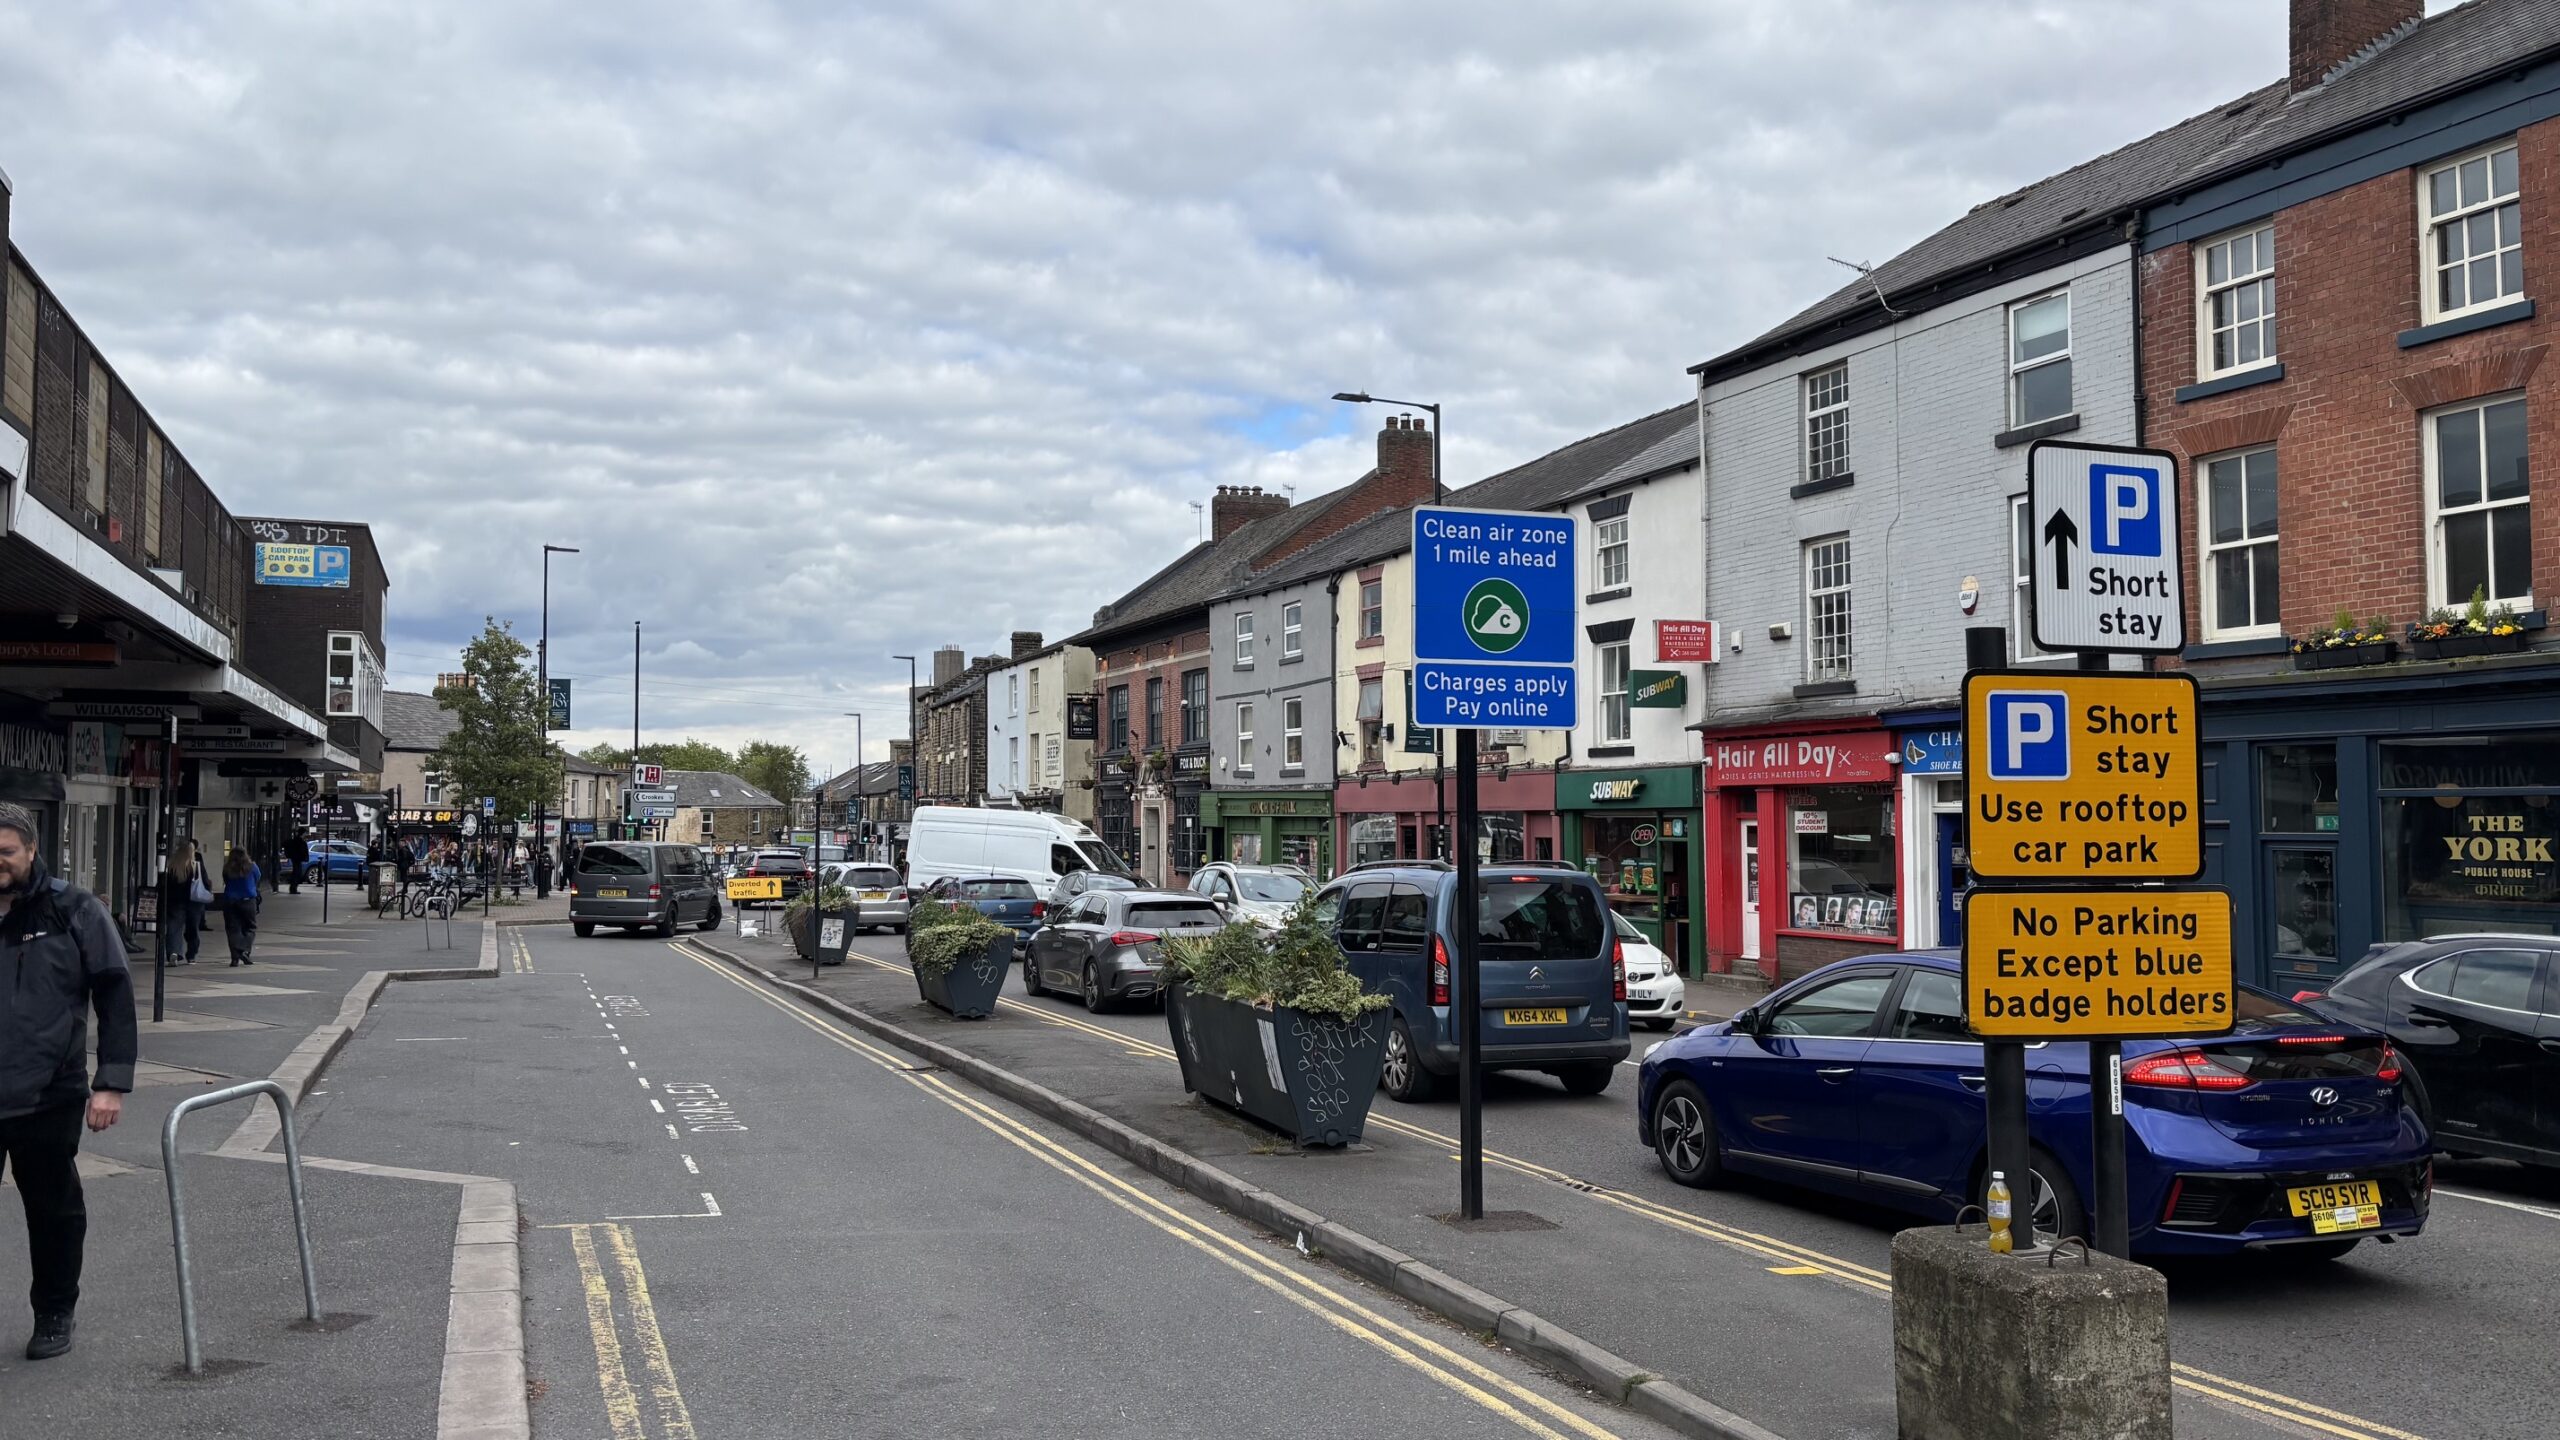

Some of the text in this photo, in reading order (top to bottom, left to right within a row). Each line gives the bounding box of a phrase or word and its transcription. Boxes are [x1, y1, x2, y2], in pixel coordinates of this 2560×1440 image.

[2105, 473, 2149, 547] P
[1423, 518, 1567, 545] Clean air zone
[268, 554, 310, 563] CAR PARK
[319, 551, 344, 573] P
[1433, 544, 1557, 568] 1 mile ahead
[2089, 567, 2169, 598] Short
[1500, 614, 1511, 628] C
[1663, 625, 1706, 635] Hair All Day
[2099, 607, 2163, 641] stay
[1424, 671, 1568, 697] Charges apply
[1636, 675, 1679, 701] SUBWAY
[75, 703, 173, 717] WILLIAMSONS
[1445, 696, 1548, 719] Pay online
[2086, 704, 2178, 735] Short
[215, 740, 276, 749] RESTAURANT
[2007, 701, 2054, 769] P
[0, 722, 65, 773] WILLIAMSONS
[1106, 764, 1115, 774] FOX
[1180, 758, 1189, 769] FOX
[1194, 756, 1206, 768] DUCK
[1718, 745, 1756, 770] Hair
[1764, 742, 1789, 768] All
[1798, 741, 1836, 777] Day
[1930, 761, 1951, 770] SHOE
[2097, 745, 2170, 779] stay
[291, 776, 312, 785] COSTA
[648, 767, 657, 778] H
[1718, 772, 1740, 780] LADIES
[1749, 771, 1769, 779] GENTS
[1771, 770, 1821, 778] HAIRDRESSING
[289, 789, 314, 799] COFFEE
[1590, 778, 1640, 800] SUBWAY
[486, 798, 492, 807] P
[1980, 793, 2188, 827] Use rooftop
[388, 810, 452, 821] GRAB & GO
[2468, 815, 2524, 832] THE
[1634, 829, 1654, 841] OPEN
[2013, 835, 2159, 869] car park
[2442, 836, 2556, 863] YORK
[2464, 866, 2533, 878] PUBLIC HOUSE
[2012, 906, 2198, 940] No Parking
[1997, 947, 2203, 982] Except blue
[1638, 989, 1652, 998] ULY
[1983, 986, 2226, 1023] badge holders
[1508, 1009, 1562, 1023] MX64 XKL
[2300, 1115, 2344, 1127] IONIQ
[2299, 1183, 2371, 1210] SC19 SYR
[2313, 1211, 2335, 1222] 36106
